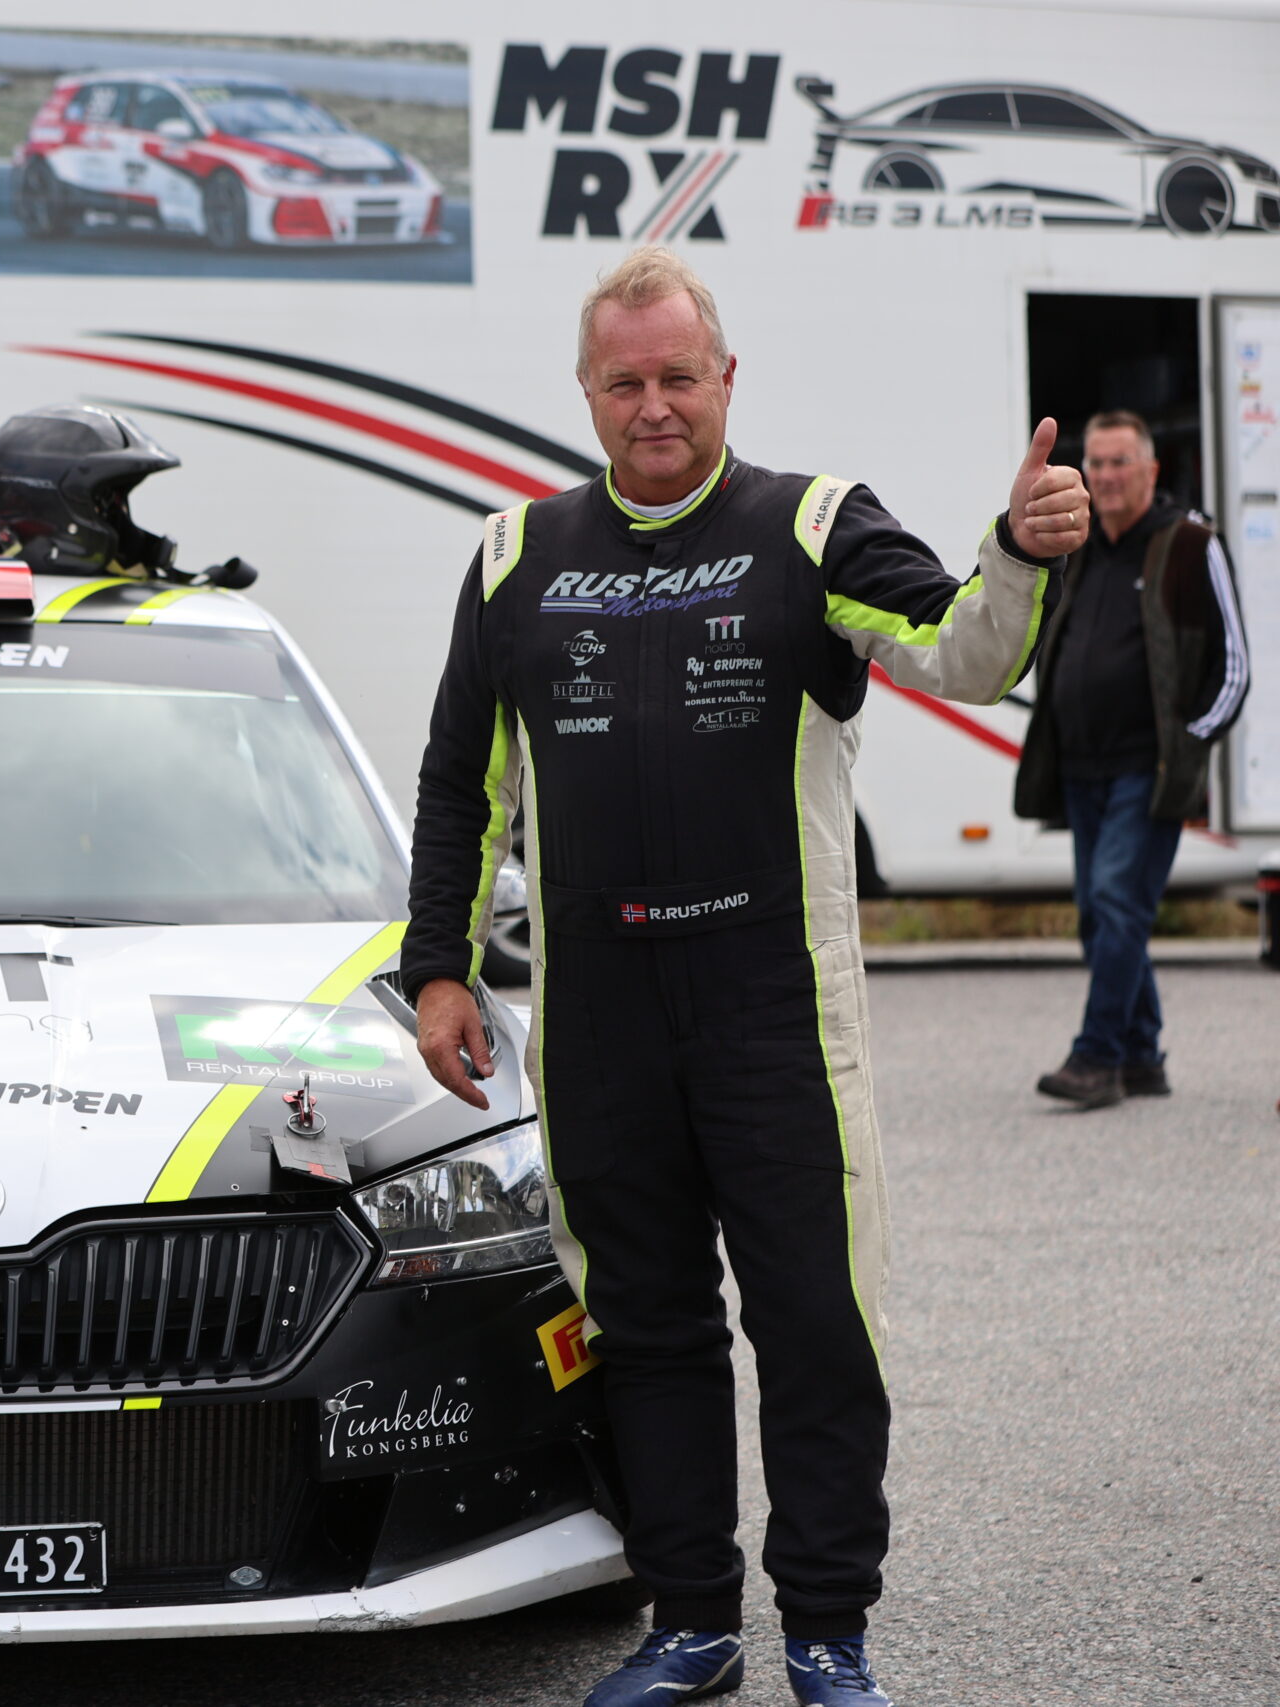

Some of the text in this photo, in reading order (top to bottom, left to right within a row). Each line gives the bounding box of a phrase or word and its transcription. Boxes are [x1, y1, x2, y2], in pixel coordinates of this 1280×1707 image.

[490, 43, 780, 140] MSH
[935, 202, 1036, 228] LMS
[812, 487, 839, 532] MARINA
[493, 515, 508, 562] MARINA
[543, 554, 754, 601] RUSTAND
[561, 641, 607, 655] FUCHS
[687, 657, 704, 676] RH
[713, 658, 762, 671] GRUPPEN
[552, 683, 615, 698] BLEFJELL
[685, 697, 716, 707] NORSKE
[649, 892, 749, 920] R.RUSTAND
[187, 1061, 394, 1089] RENTAL GROUP
[325, 1380, 474, 1457] Funkelia
[346, 1430, 470, 1458] KONGSBERG
